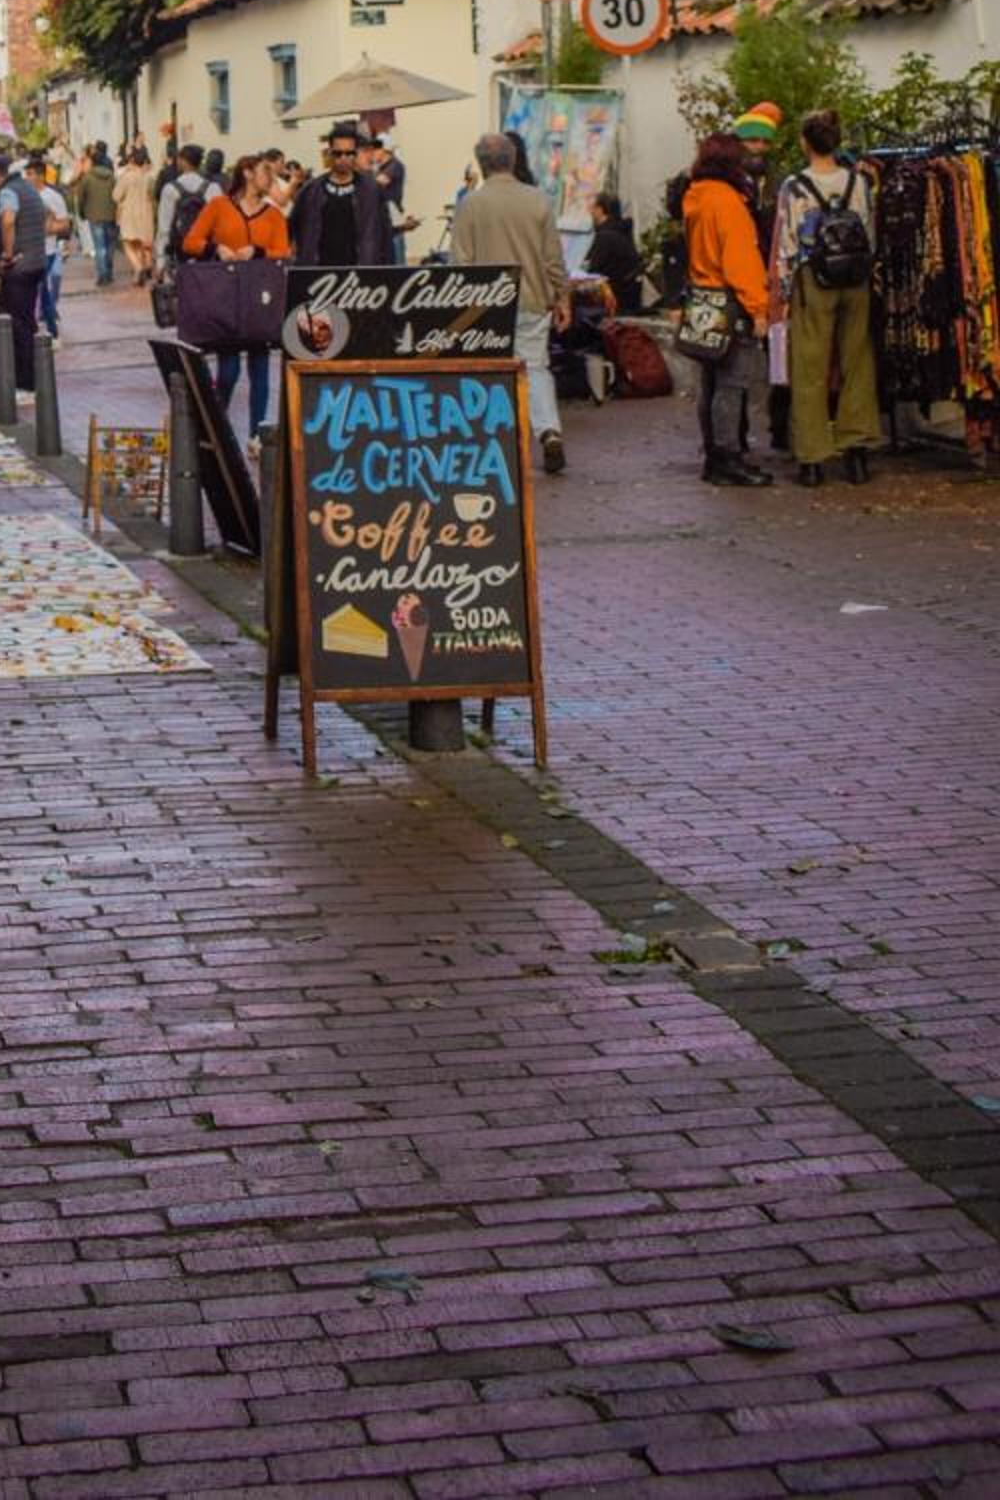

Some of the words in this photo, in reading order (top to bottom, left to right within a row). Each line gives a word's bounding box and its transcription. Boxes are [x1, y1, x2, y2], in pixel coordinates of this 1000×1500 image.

[307, 271, 388, 316] Vino
[392, 269, 518, 314] Caliente
[459, 328, 511, 351] Wine
[304, 377, 515, 450] MALTEADA
[311, 454, 358, 493] de
[362, 438, 516, 506] CERVEZA
[321, 500, 496, 562] Coffee
[323, 545, 521, 608] Canelazo
[450, 606, 511, 631] SODA
